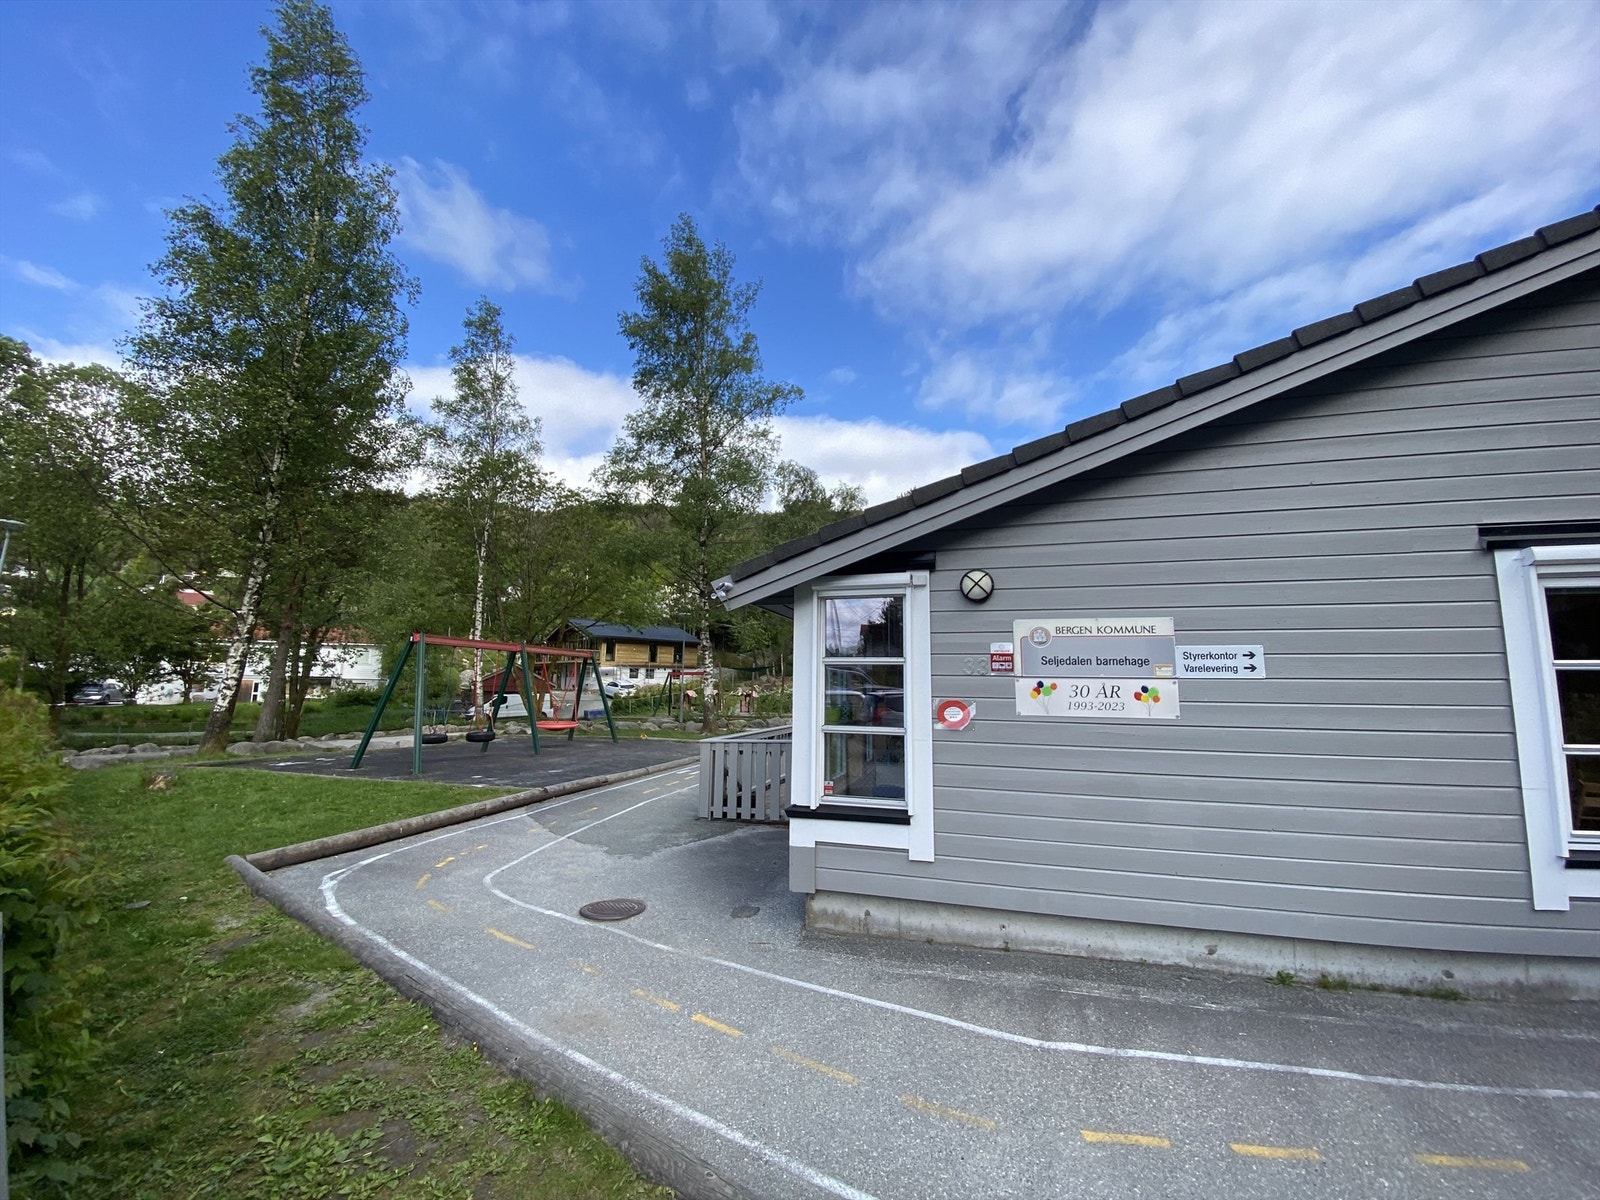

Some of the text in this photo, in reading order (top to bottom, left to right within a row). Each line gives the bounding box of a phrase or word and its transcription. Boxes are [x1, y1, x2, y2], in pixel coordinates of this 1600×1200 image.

[1055, 625, 1156, 635] BERGEN KOMMUNE
[1182, 651, 1238, 661] Styrerkontor
[1040, 656, 1150, 667] Seljedalen barnehage
[1183, 664, 1239, 674] Varelevering
[1069, 682, 1121, 698] 30 ÅR
[1067, 701, 1125, 711] 1993-2023
